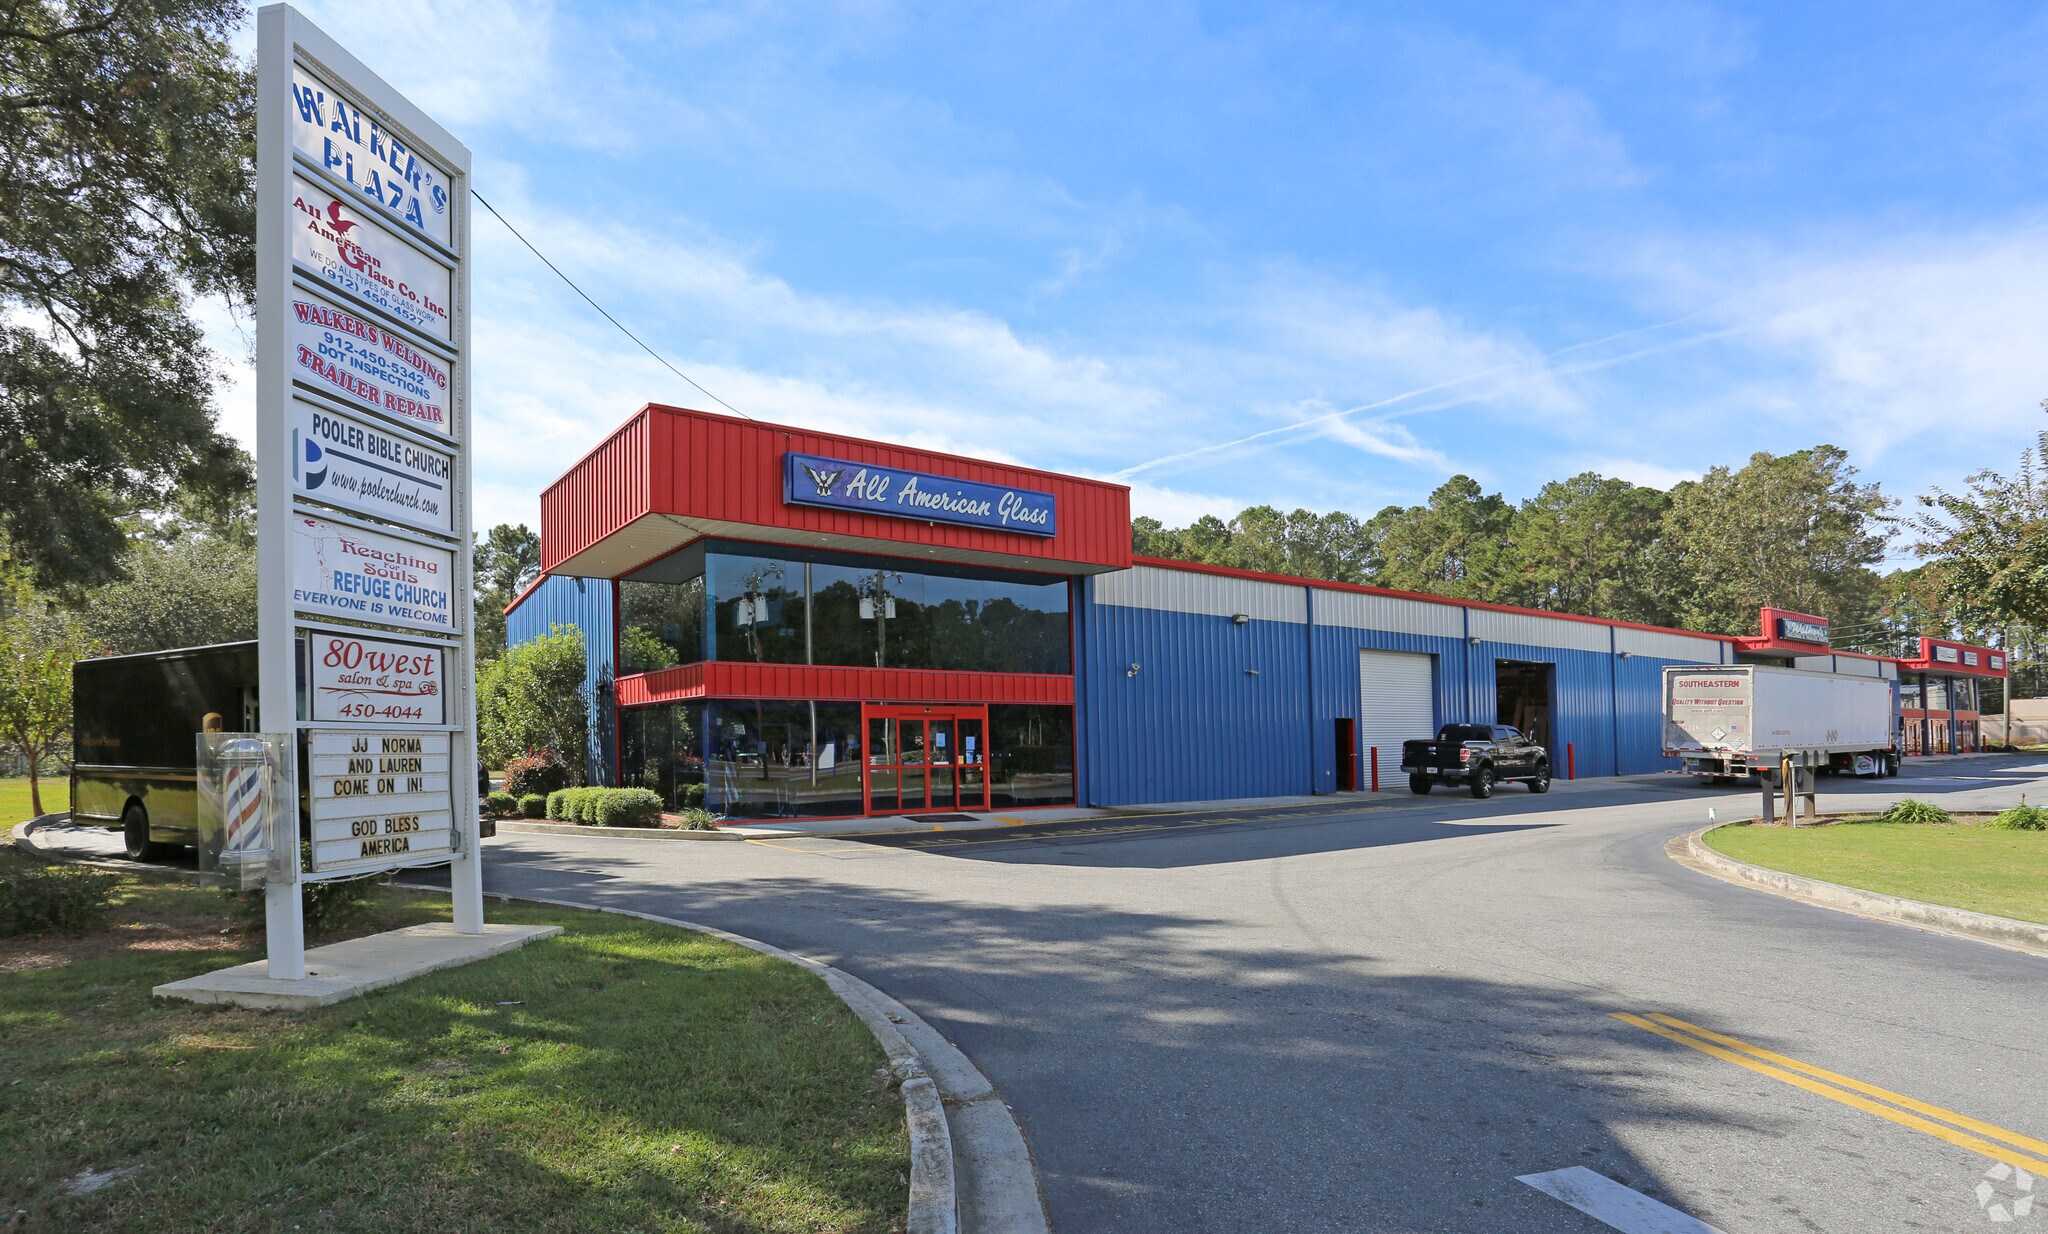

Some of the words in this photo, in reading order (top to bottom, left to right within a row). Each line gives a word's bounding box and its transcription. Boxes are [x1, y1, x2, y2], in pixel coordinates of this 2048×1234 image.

[292, 82, 447, 215] WALKER'S
[324, 136, 424, 230] PLAZA
[293, 197, 321, 221] All
[308, 220, 381, 268] American
[309, 248, 323, 261] WE
[325, 256, 337, 269] DO
[339, 265, 353, 279] ALL
[355, 272, 378, 293] TYPES
[381, 287, 389, 298] OF
[392, 293, 415, 312] GLASS
[415, 306, 436, 324] WORK
[322, 265, 359, 292] (912)
[362, 290, 424, 325] 450-4527
[337, 245, 395, 289] Glass
[398, 282, 420, 304] Co.
[423, 296, 448, 320] Inc.
[292, 301, 378, 345] WALKER'S
[381, 331, 446, 389] WELDING
[323, 332, 425, 386] 912-450-5342
[298, 345, 380, 405] TRAILER
[384, 391, 444, 424] REPAIR
[318, 342, 346, 361] DOT
[350, 356, 431, 400] INSPECTIONS
[313, 413, 364, 451] POOLER
[368, 433, 402, 464] BIBLE
[404, 447, 449, 480] CHURCH
[331, 471, 440, 516] www.poolerchurch.com
[845, 468, 890, 502] All
[897, 476, 991, 517] American
[997, 491, 1048, 525] Glass
[341, 540, 438, 574] Reaching
[364, 562, 418, 584] Souls
[383, 561, 400, 571] For
[293, 589, 367, 611] EVERYONE
[371, 602, 383, 613] IS
[388, 605, 448, 624] WELCOME
[333, 570, 391, 600] REFUGE
[395, 583, 447, 610] CHURCH
[338, 671, 371, 686] salon
[376, 675, 390, 689] &
[393, 679, 413, 692] spa
[1678, 680, 1740, 688] SOUTHEASTERN
[340, 704, 423, 719] 450-4044
[1671, 698, 1693, 706] QUALITY
[1718, 698, 1744, 706] QUESTION
[352, 738, 368, 753] JJ
[382, 738, 422, 753] NORMA
[348, 758, 373, 774] AND
[380, 758, 422, 774] LAUREN
[334, 779, 369, 795] COME
[377, 778, 394, 793] ON
[407, 778, 422, 792] IN!
[352, 820, 377, 837] GOD
[385, 816, 419, 833] BLESS
[361, 838, 409, 857] AMERICA
